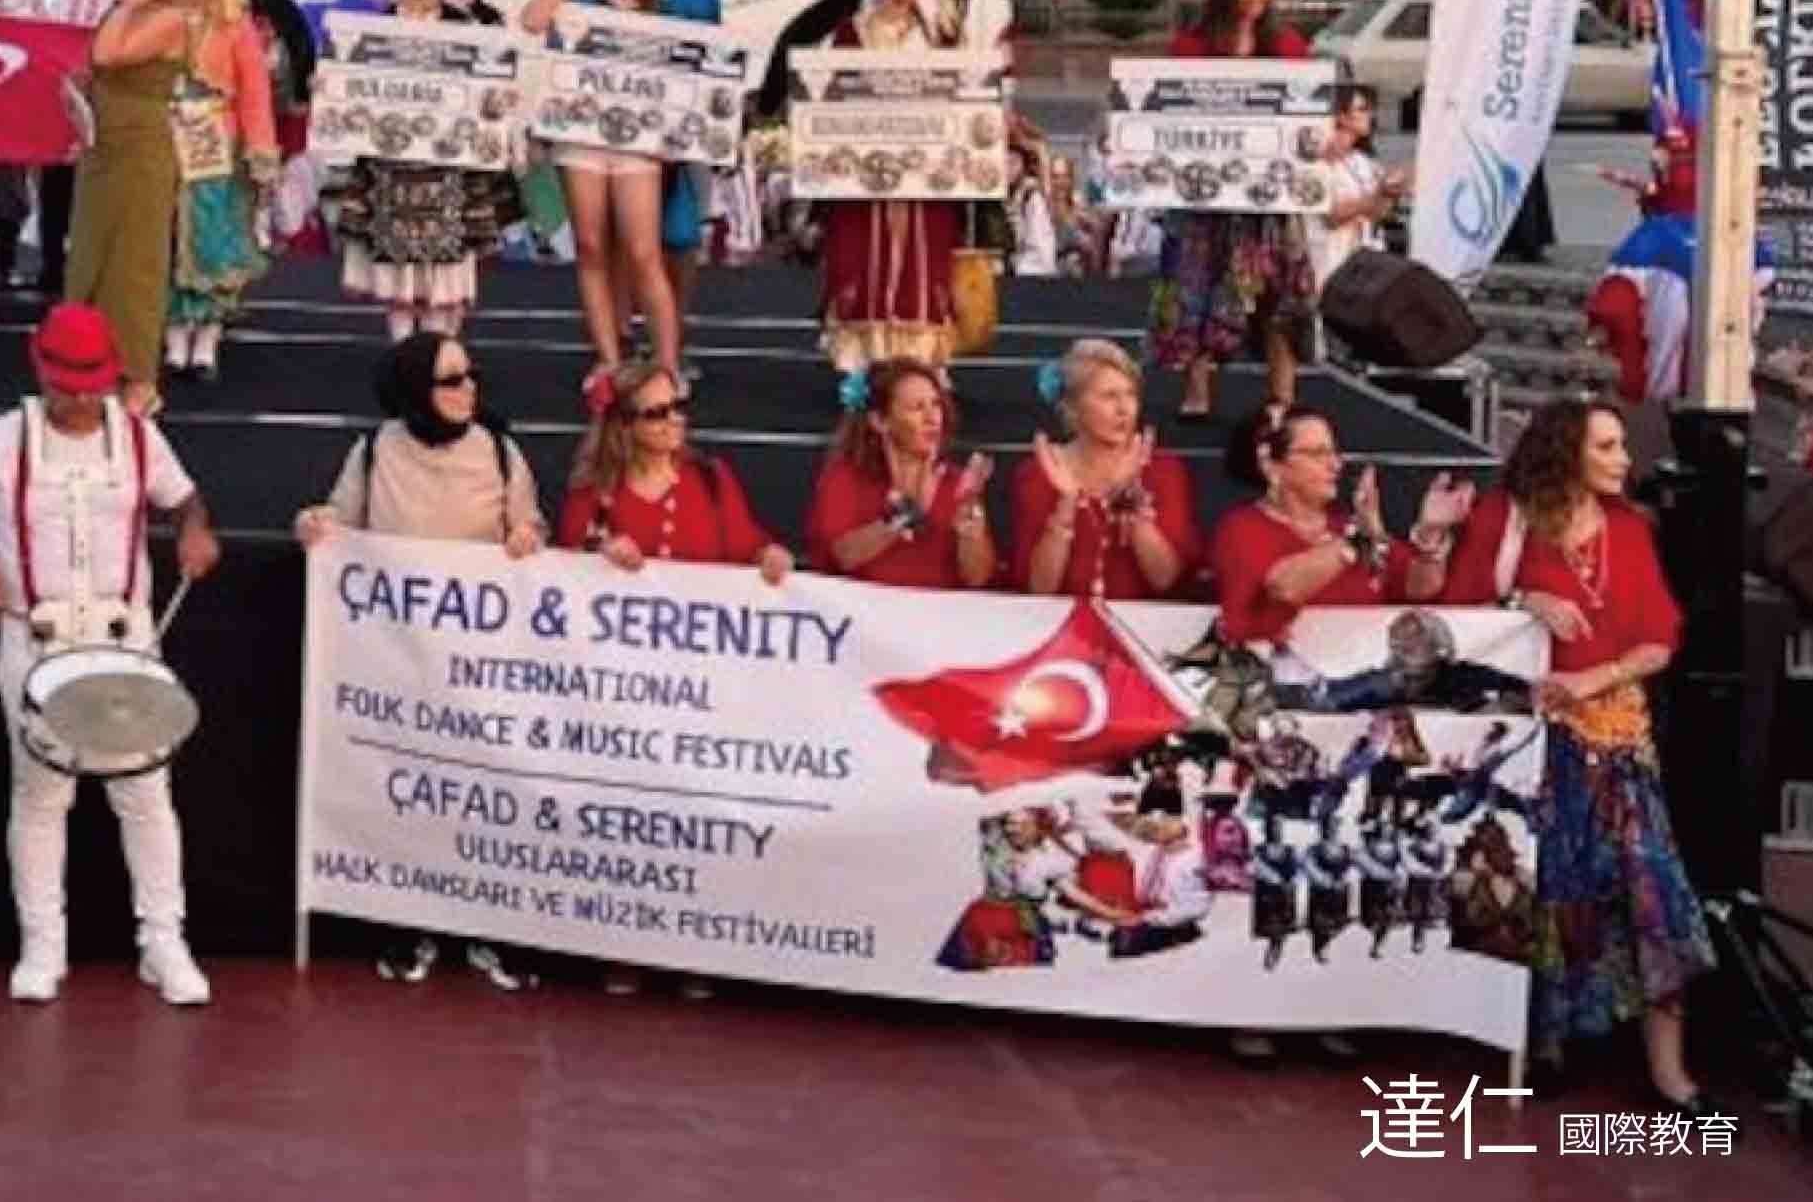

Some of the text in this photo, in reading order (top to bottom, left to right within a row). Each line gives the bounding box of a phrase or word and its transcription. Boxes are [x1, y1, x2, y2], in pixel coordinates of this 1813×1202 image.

[339, 562, 852, 664] ÇAFAD & SERENITY
[448, 653, 713, 710] INTERNATIONAL
[336, 683, 852, 780] FOLK DANCE & MUSIC FESTIVALS
[387, 768, 775, 859] ÇAFAD & SERENITY
[313, 851, 382, 884] HALK
[390, 862, 524, 911] DANSLARI
[530, 886, 565, 917] VE
[455, 831, 698, 895] ULUSLARARASI
